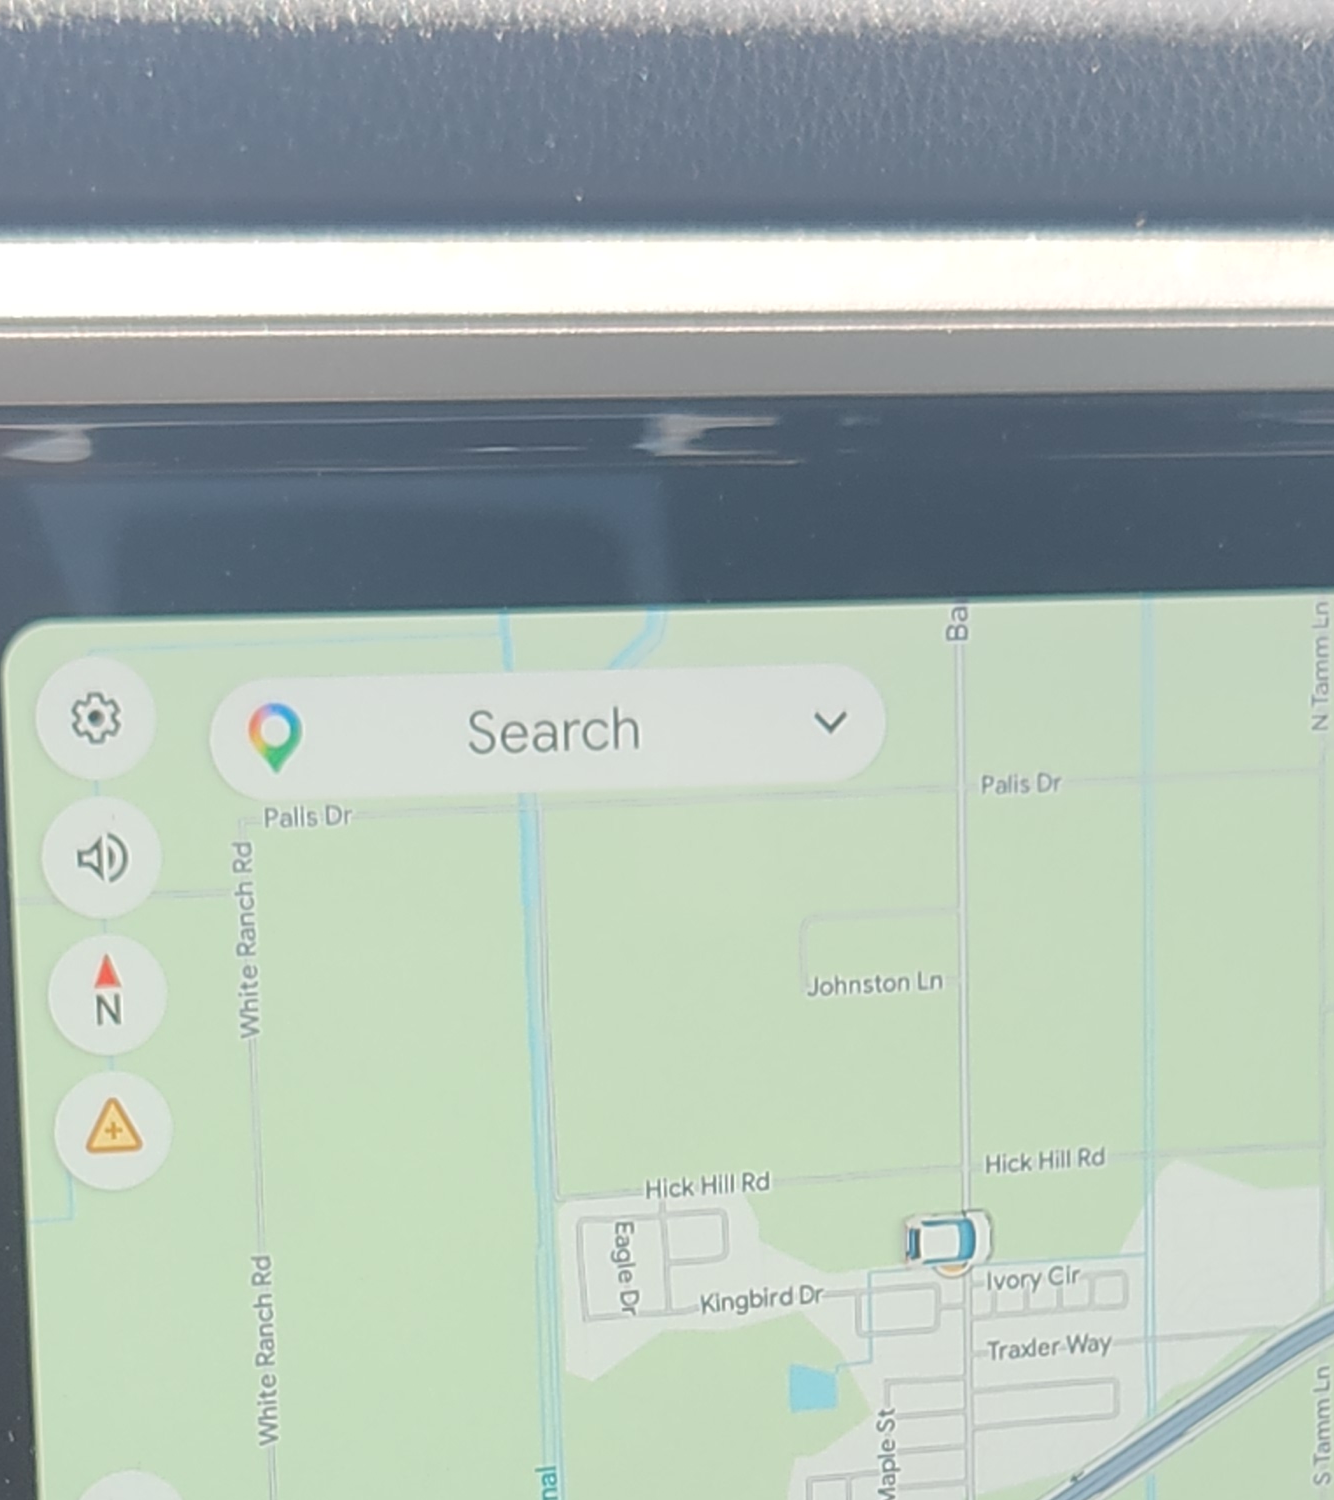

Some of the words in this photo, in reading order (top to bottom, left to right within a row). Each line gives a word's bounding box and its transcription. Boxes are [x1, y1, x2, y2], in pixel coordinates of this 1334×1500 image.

[1312, 601, 1329, 628] Ln
[1312, 636, 1329, 705] Tamm
[469, 706, 640, 755] Search
[1312, 715, 1329, 731] N
[981, 773, 1030, 795] Palis
[1037, 772, 1061, 793] Dr
[325, 804, 353, 826] Dr
[232, 842, 253, 873] Rd
[234, 881, 258, 956] Ranch
[807, 974, 910, 997] Johnston
[917, 972, 943, 991] Ln
[96, 993, 122, 1025] N
[239, 963, 261, 1039] White
[985, 1153, 1032, 1174] Hick
[1039, 1150, 1072, 1171] Hill
[1079, 1147, 1105, 1167] Rd
[645, 1178, 694, 1199] Hick
[702, 1174, 735, 1196] Hill
[742, 1172, 770, 1193] Rd
[611, 1221, 637, 1284] Eagle
[252, 1255, 273, 1287] Rd
[987, 1269, 1041, 1293] Ivory
[1048, 1264, 1081, 1286] Cir
[620, 1290, 640, 1316] Dr
[700, 1286, 794, 1315] Kingbird
[799, 1283, 824, 1304] Dr
[253, 1293, 276, 1368] Ranch
[989, 1338, 1060, 1361] Traxler
[1067, 1333, 1112, 1357] Way
[1313, 1364, 1331, 1391] Ln
[257, 1374, 280, 1447] White
[876, 1408, 897, 1431] St
[1313, 1398, 1331, 1463] Tamm
[1313, 1471, 1331, 1486] S
